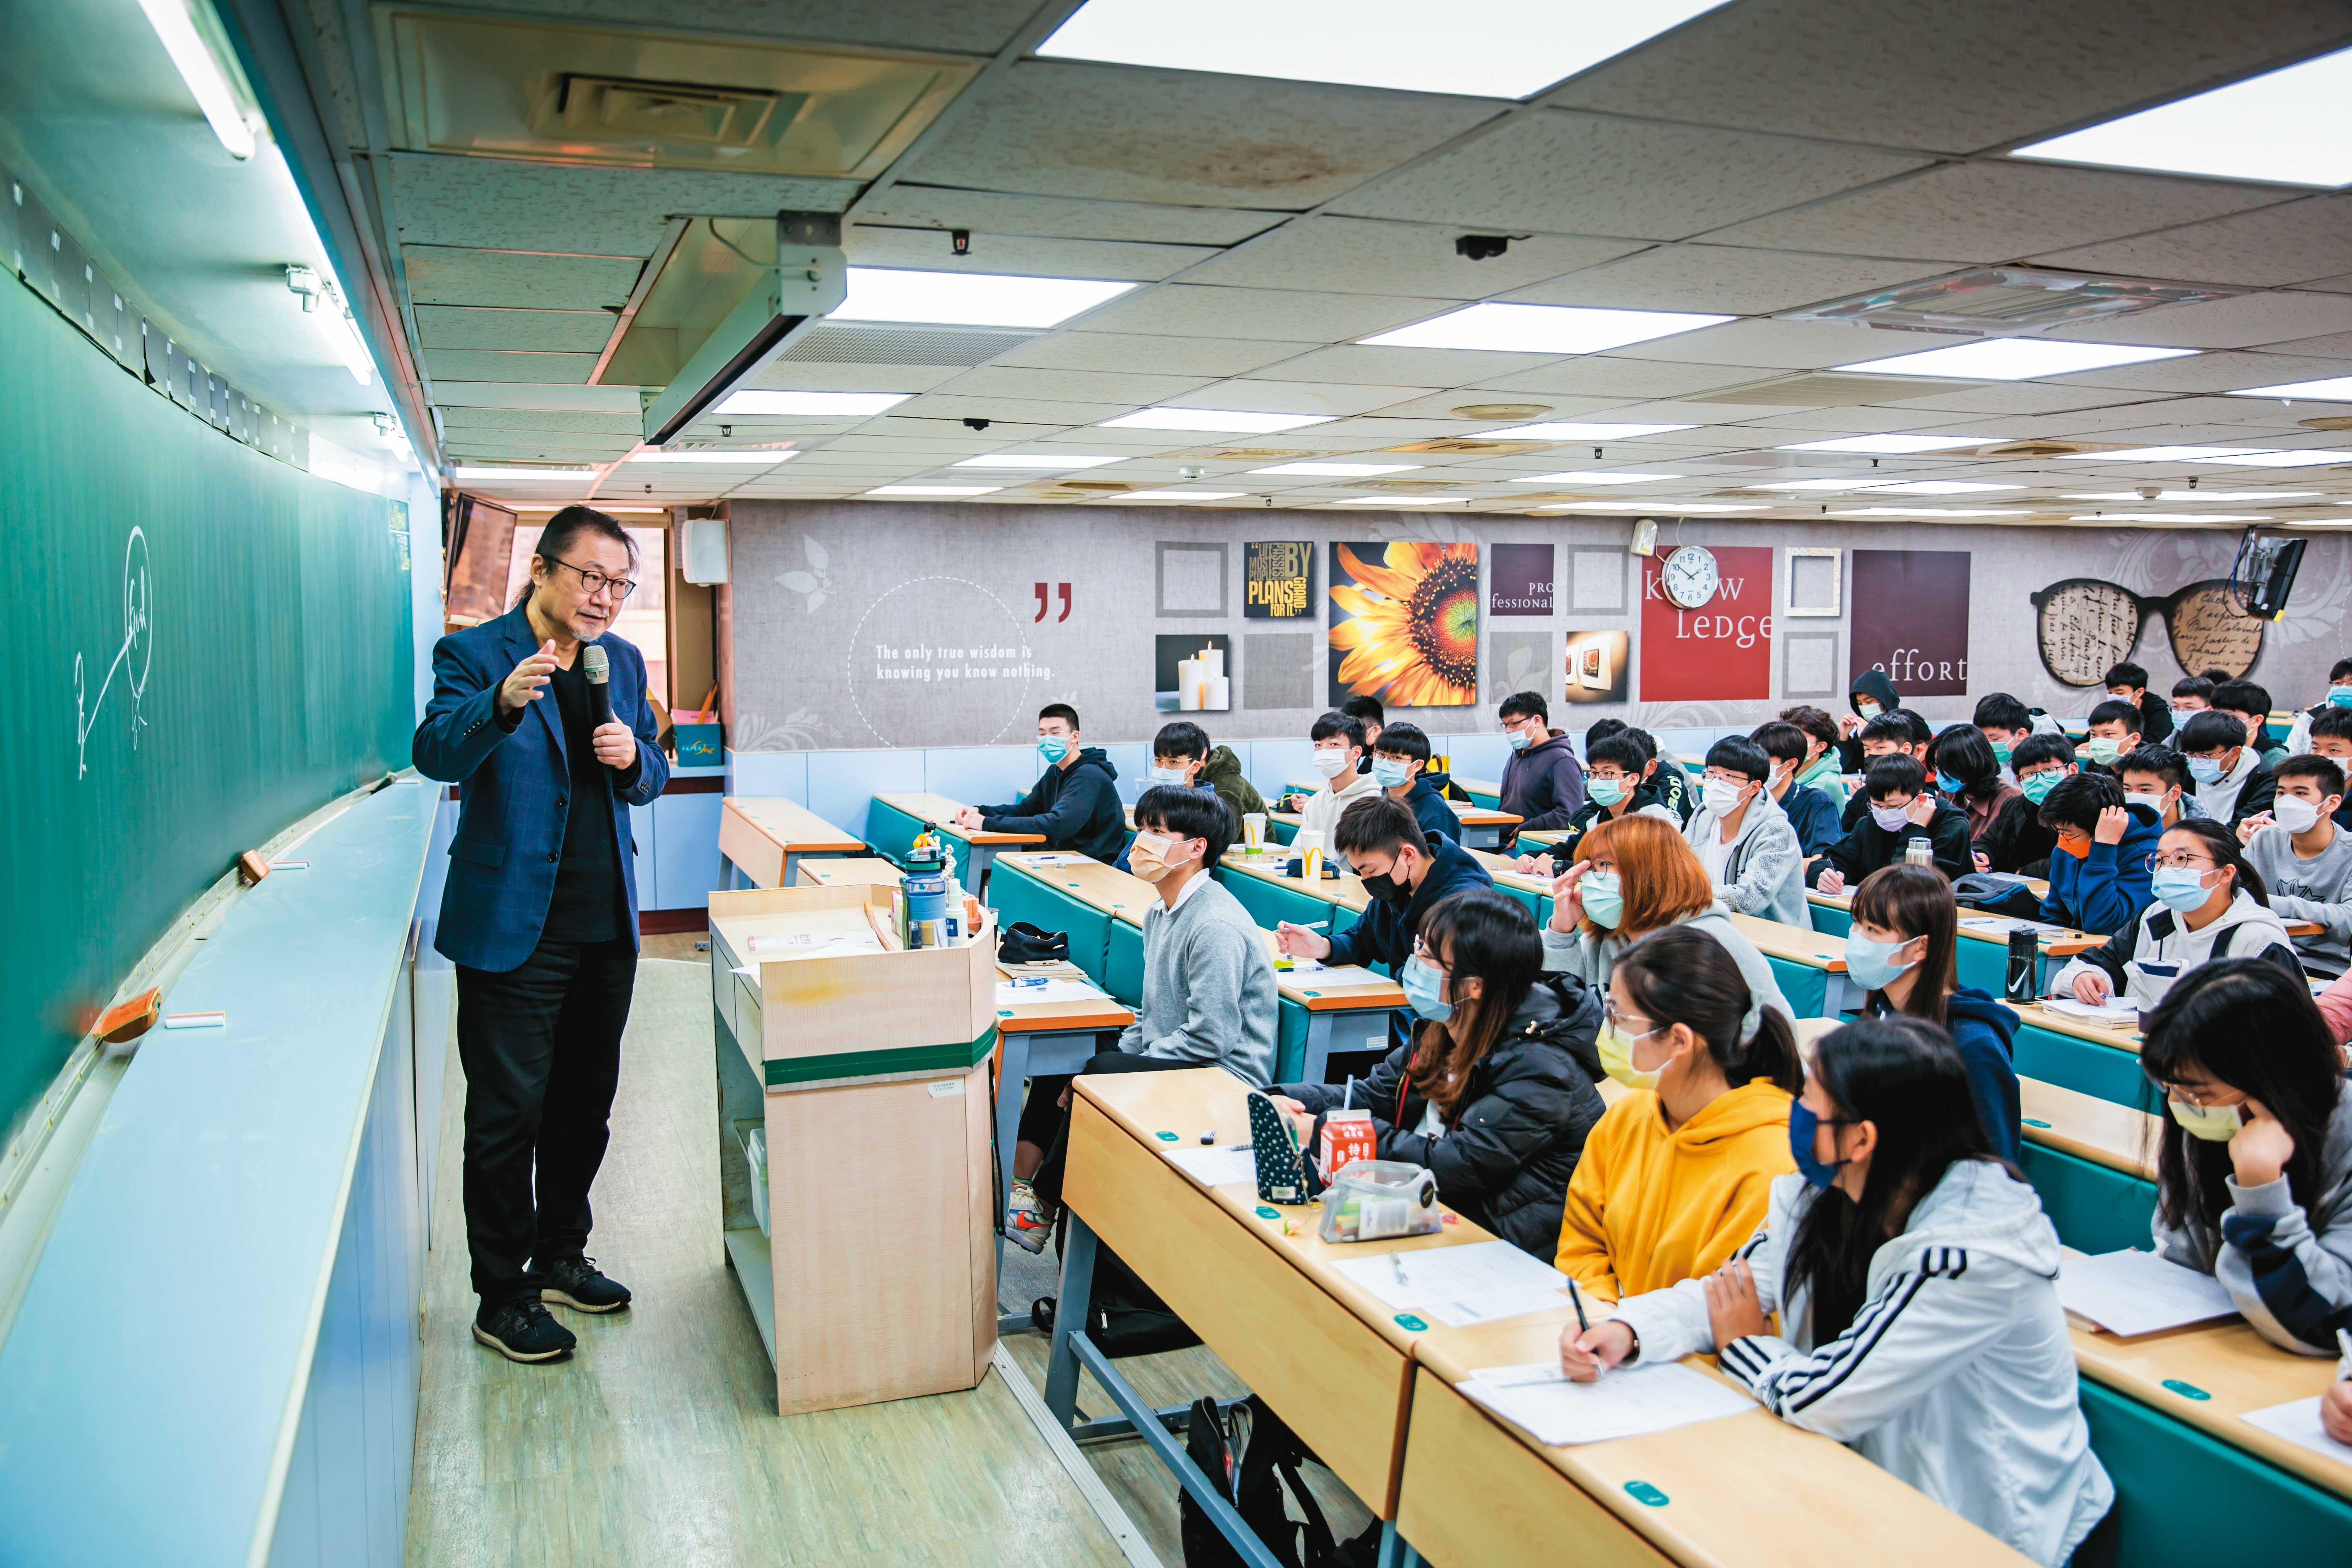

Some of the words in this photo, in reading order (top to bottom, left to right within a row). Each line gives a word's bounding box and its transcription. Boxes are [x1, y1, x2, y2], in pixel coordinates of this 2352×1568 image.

[1249, 556, 1272, 570] MOST
[1272, 542, 1285, 577] PASSES
[1285, 543, 1312, 577] BY
[1249, 570, 1272, 581] PEOPLE
[1248, 580, 1294, 605] PLANS
[1293, 577, 1306, 608] GRAND
[1270, 603, 1285, 617] FOR
[876, 644, 899, 659] The
[904, 644, 932, 662] only
[938, 646, 964, 659] true
[969, 643, 1016, 659] wisdom
[1022, 645, 1032, 659] is
[877, 664, 931, 682] knowing
[937, 667, 959, 682] you
[965, 663, 998, 678] know
[1003, 662, 1056, 680] nothing.
